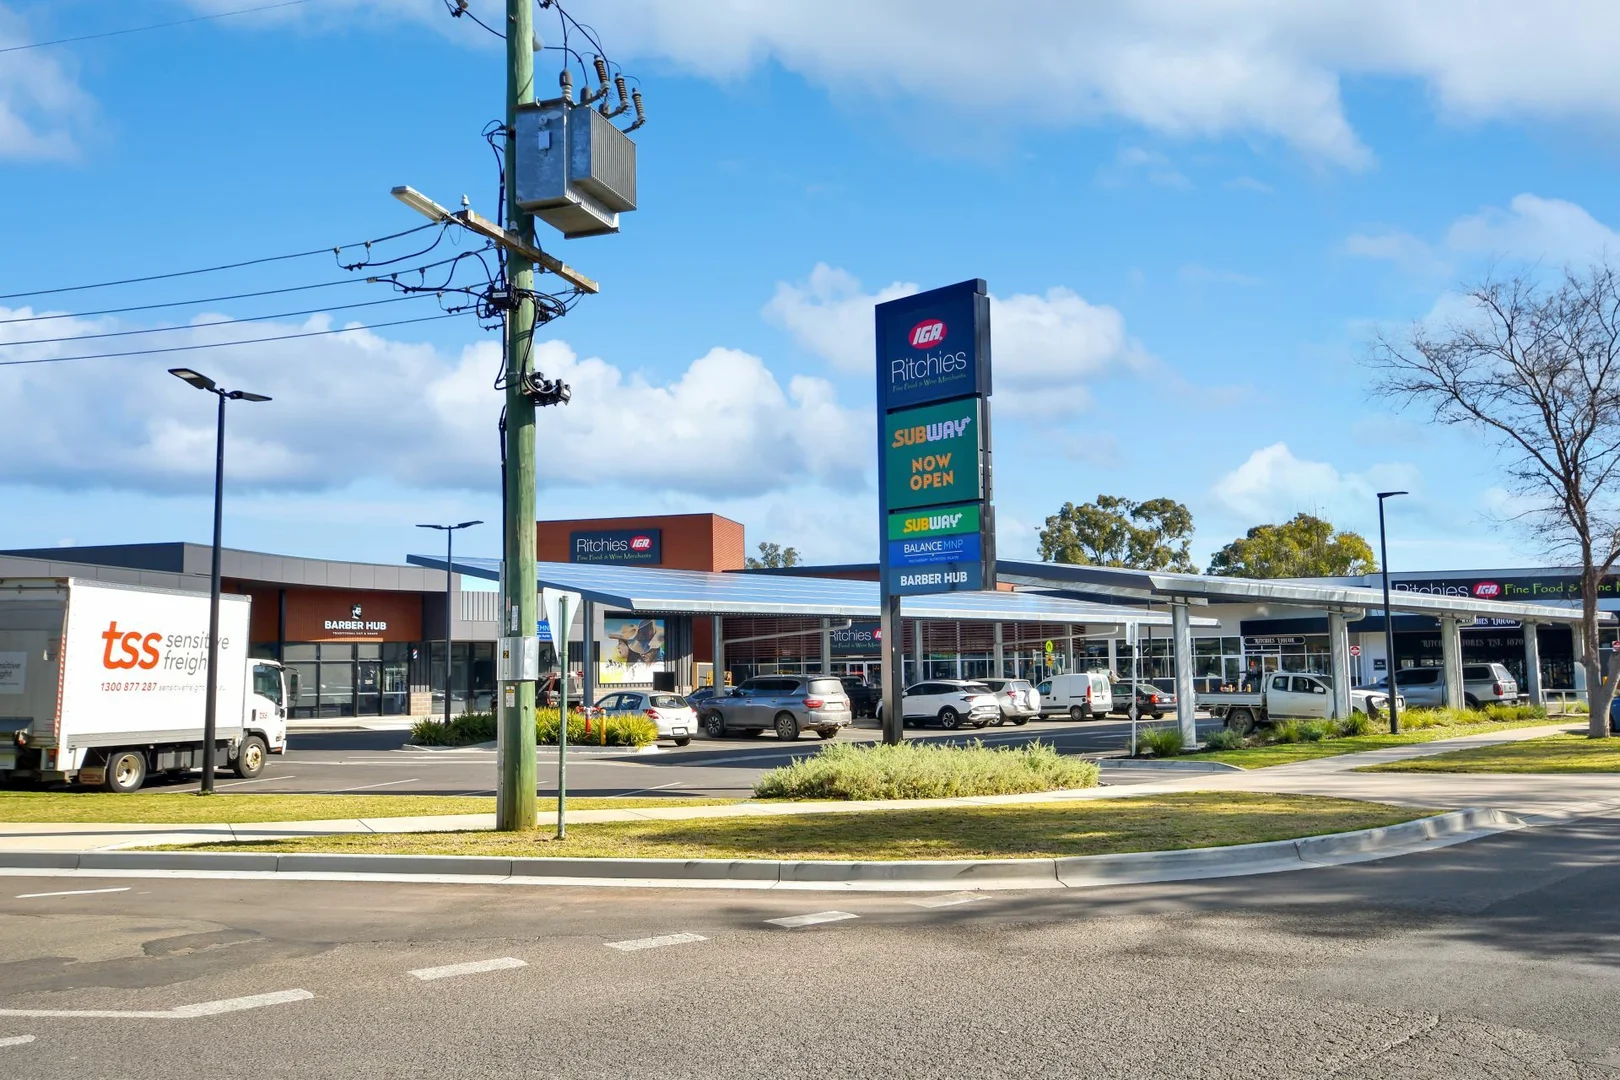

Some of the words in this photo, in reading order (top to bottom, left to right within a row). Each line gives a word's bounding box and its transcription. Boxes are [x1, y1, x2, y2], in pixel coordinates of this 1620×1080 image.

[913, 323, 943, 345] IGA
[892, 351, 967, 383] Ritchies
[892, 416, 972, 448] SUBWAY
[911, 453, 952, 473] NOW
[910, 470, 954, 491] OPEN
[903, 513, 963, 533] SUBWAY
[576, 538, 628, 552] Ritchies
[632, 538, 650, 548] IGA
[904, 541, 943, 554] BALANCE
[943, 540, 964, 550] MNP
[900, 573, 942, 587] BARBER
[944, 571, 968, 584] HUB
[1476, 585, 1498, 595] IGA
[1504, 583, 1529, 595] Fine
[1533, 582, 1563, 594] Food
[1568, 584, 1577, 593] &
[324, 620, 364, 630] BARBER
[365, 621, 387, 631] HUB
[101, 621, 163, 670] tss
[165, 631, 230, 650] sensitve
[1462, 639, 1484, 647] TORES
[164, 650, 208, 676] freigh
[101, 683, 121, 692] 1300
[123, 682, 140, 692] 877
[141, 682, 158, 692] 287
